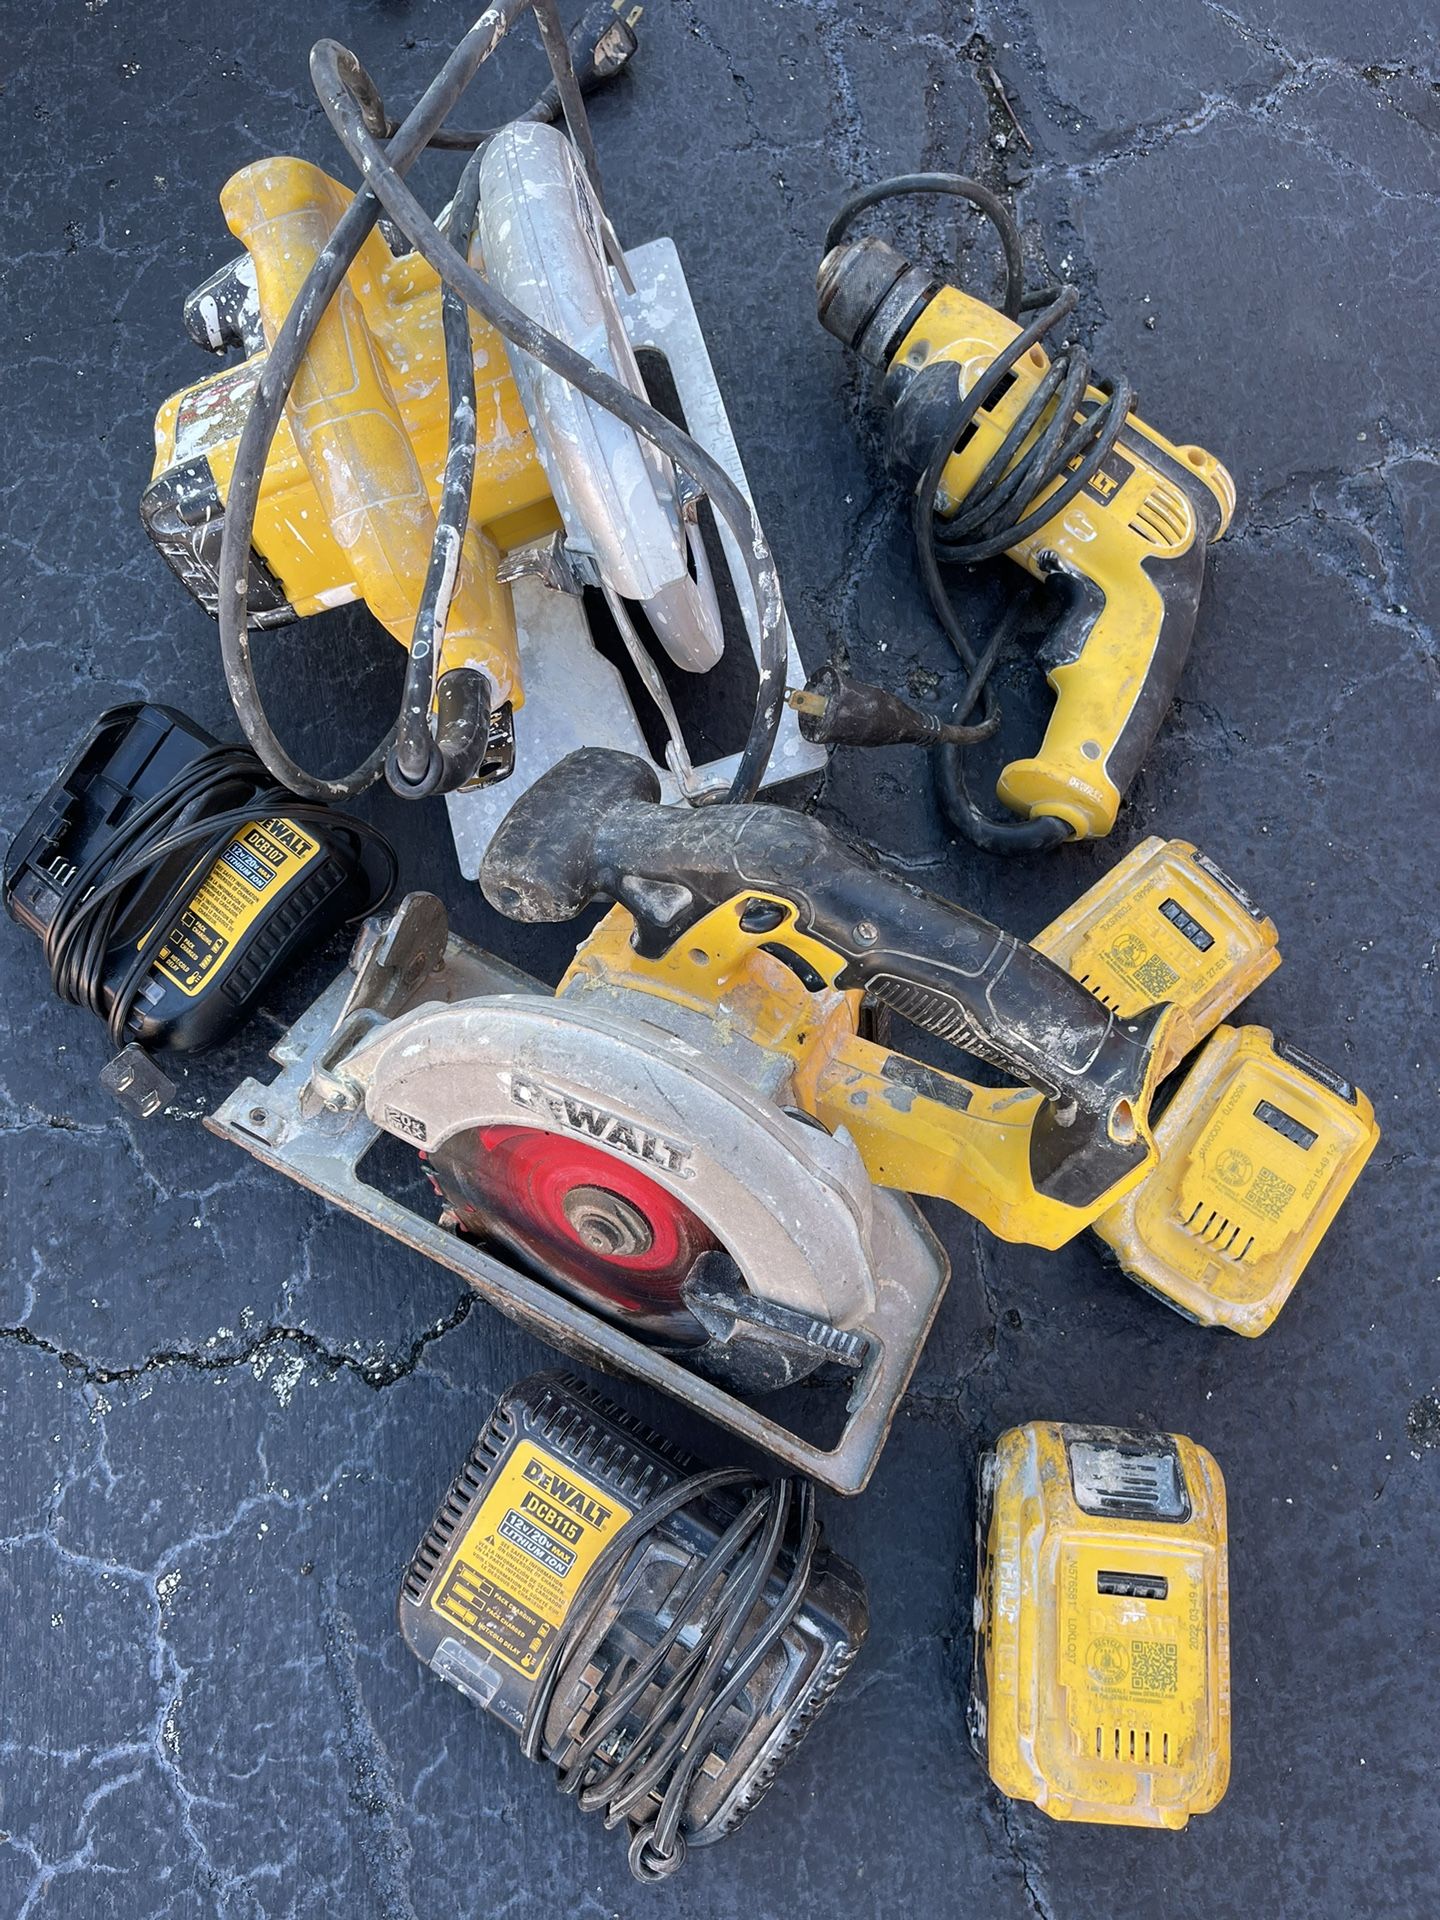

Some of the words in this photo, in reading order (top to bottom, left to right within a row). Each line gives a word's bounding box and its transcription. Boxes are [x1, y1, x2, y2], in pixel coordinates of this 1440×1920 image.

[256, 816, 311, 856] EWALT
[248, 831, 283, 864] DCB107
[224, 852, 251, 876] LITHIUM
[249, 873, 264, 887] ION
[257, 867, 271, 879] MAX
[235, 880, 259, 902] INFORMATION
[191, 926, 212, 945] CHARGING
[194, 920, 206, 932] PACK
[179, 942, 199, 961] CHARGED
[183, 937, 195, 949] PACK
[165, 958, 179, 972] DELAY
[1300, 1178, 1317, 1200] 2023
[525, 1496, 579, 1539] DCB115
[501, 1524, 545, 1559] LITHIUM
[544, 1554, 566, 1573] ION
[510, 1548, 528, 1562] SAFETY
[550, 1545, 571, 1563] MAX
[489, 1555, 504, 1568] PARTE
[493, 1592, 509, 1606] PACK
[507, 1602, 536, 1625] CHARGING
[485, 1607, 501, 1620] PACK
[499, 1617, 526, 1638] CHARGED
[477, 1621, 504, 1643] HOT/COLD
[502, 1640, 520, 1655] DELAY
[1189, 1623, 1199, 1649] 2022
